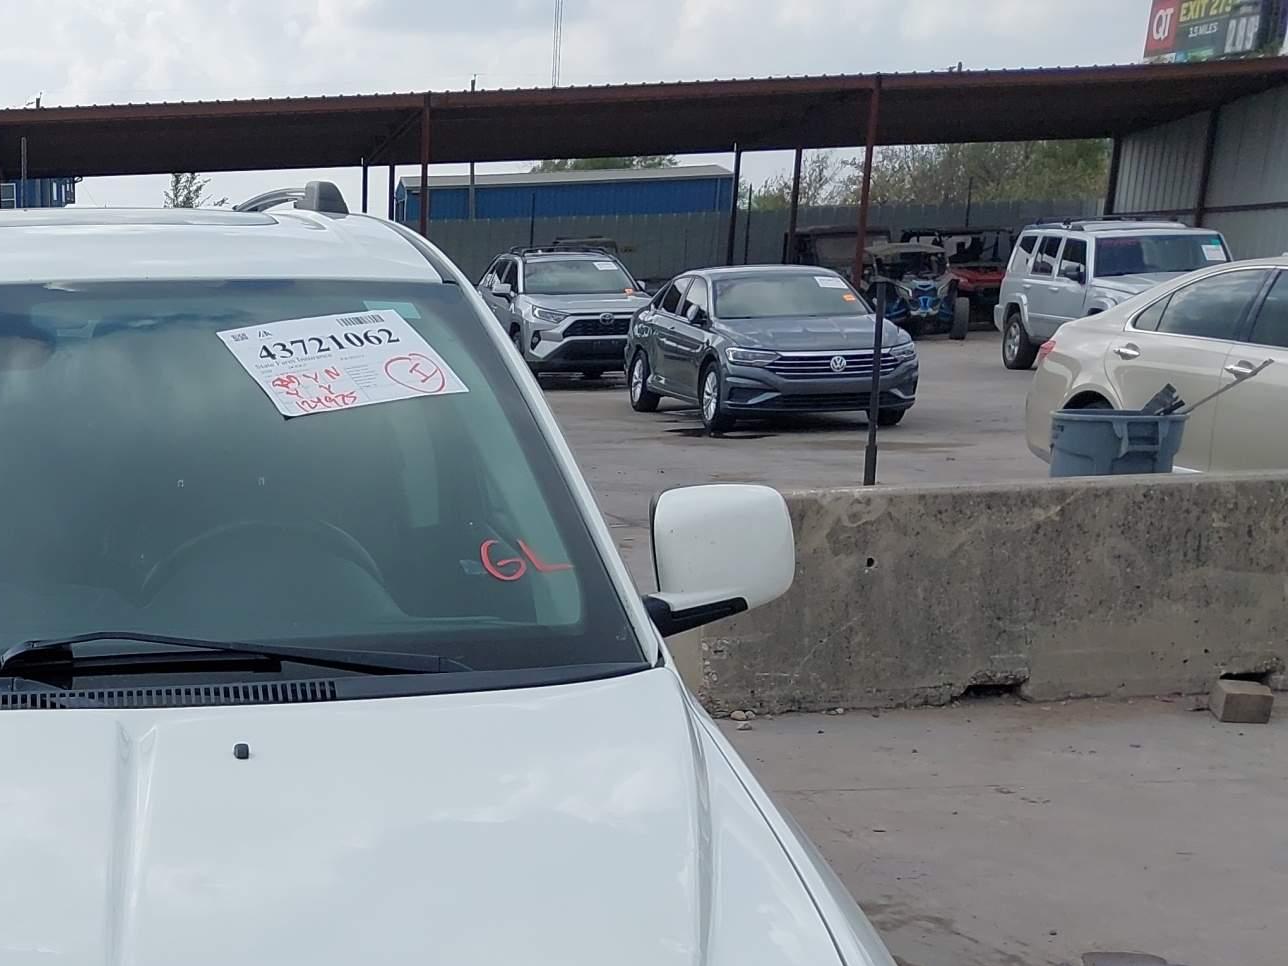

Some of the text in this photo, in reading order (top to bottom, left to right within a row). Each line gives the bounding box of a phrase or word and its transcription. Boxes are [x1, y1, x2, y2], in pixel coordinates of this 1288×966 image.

[1152, 8, 1174, 40] QT
[1179, 0, 1208, 21] EXIT
[259, 328, 400, 361] 43721062
[480, 538, 575, 581] GL
